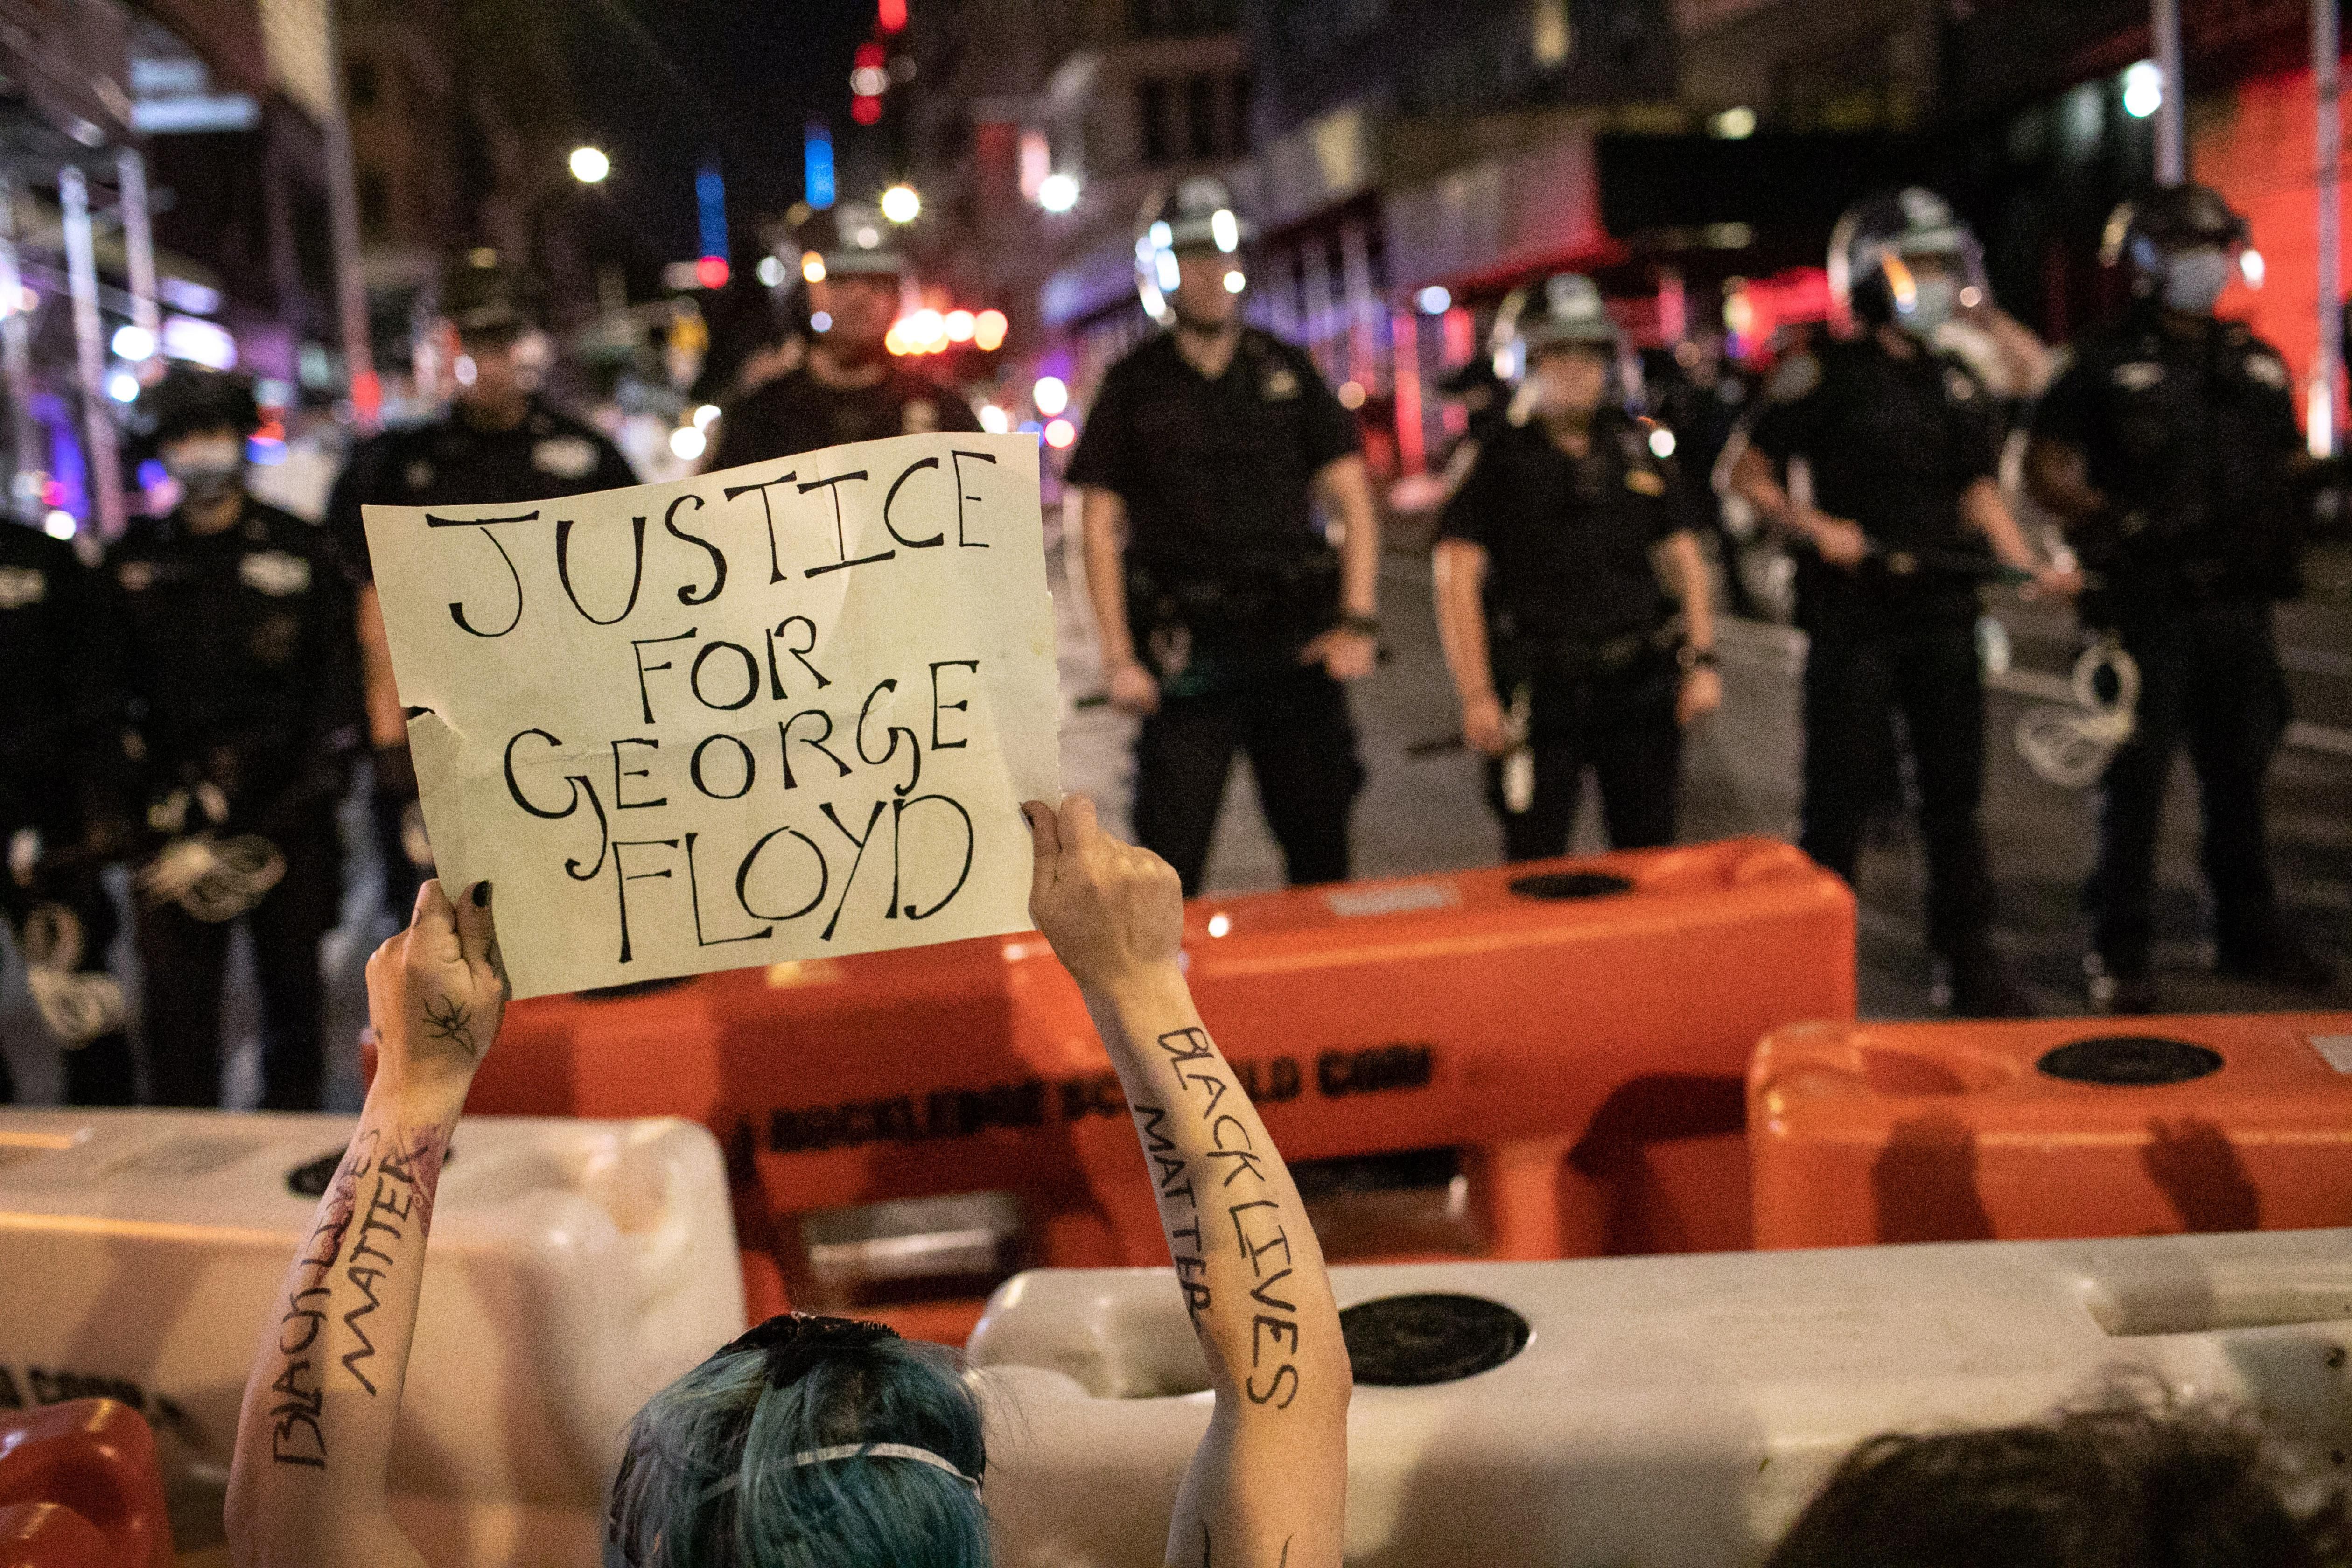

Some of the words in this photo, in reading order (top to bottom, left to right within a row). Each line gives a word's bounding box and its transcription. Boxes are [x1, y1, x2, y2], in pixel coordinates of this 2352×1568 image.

[425, 450, 997, 637] JUSTICE
[504, 659, 980, 881] GEORGE
[630, 616, 831, 724] FOR
[612, 795, 974, 963] FLOYD
[341, 1145, 429, 1397] MATTER
[1134, 1104, 1212, 1336] MATTER
[1157, 1026, 1265, 1187] BLACK
[1229, 1199, 1299, 1410] LIVES
[270, 1287, 332, 1470] BLACK
